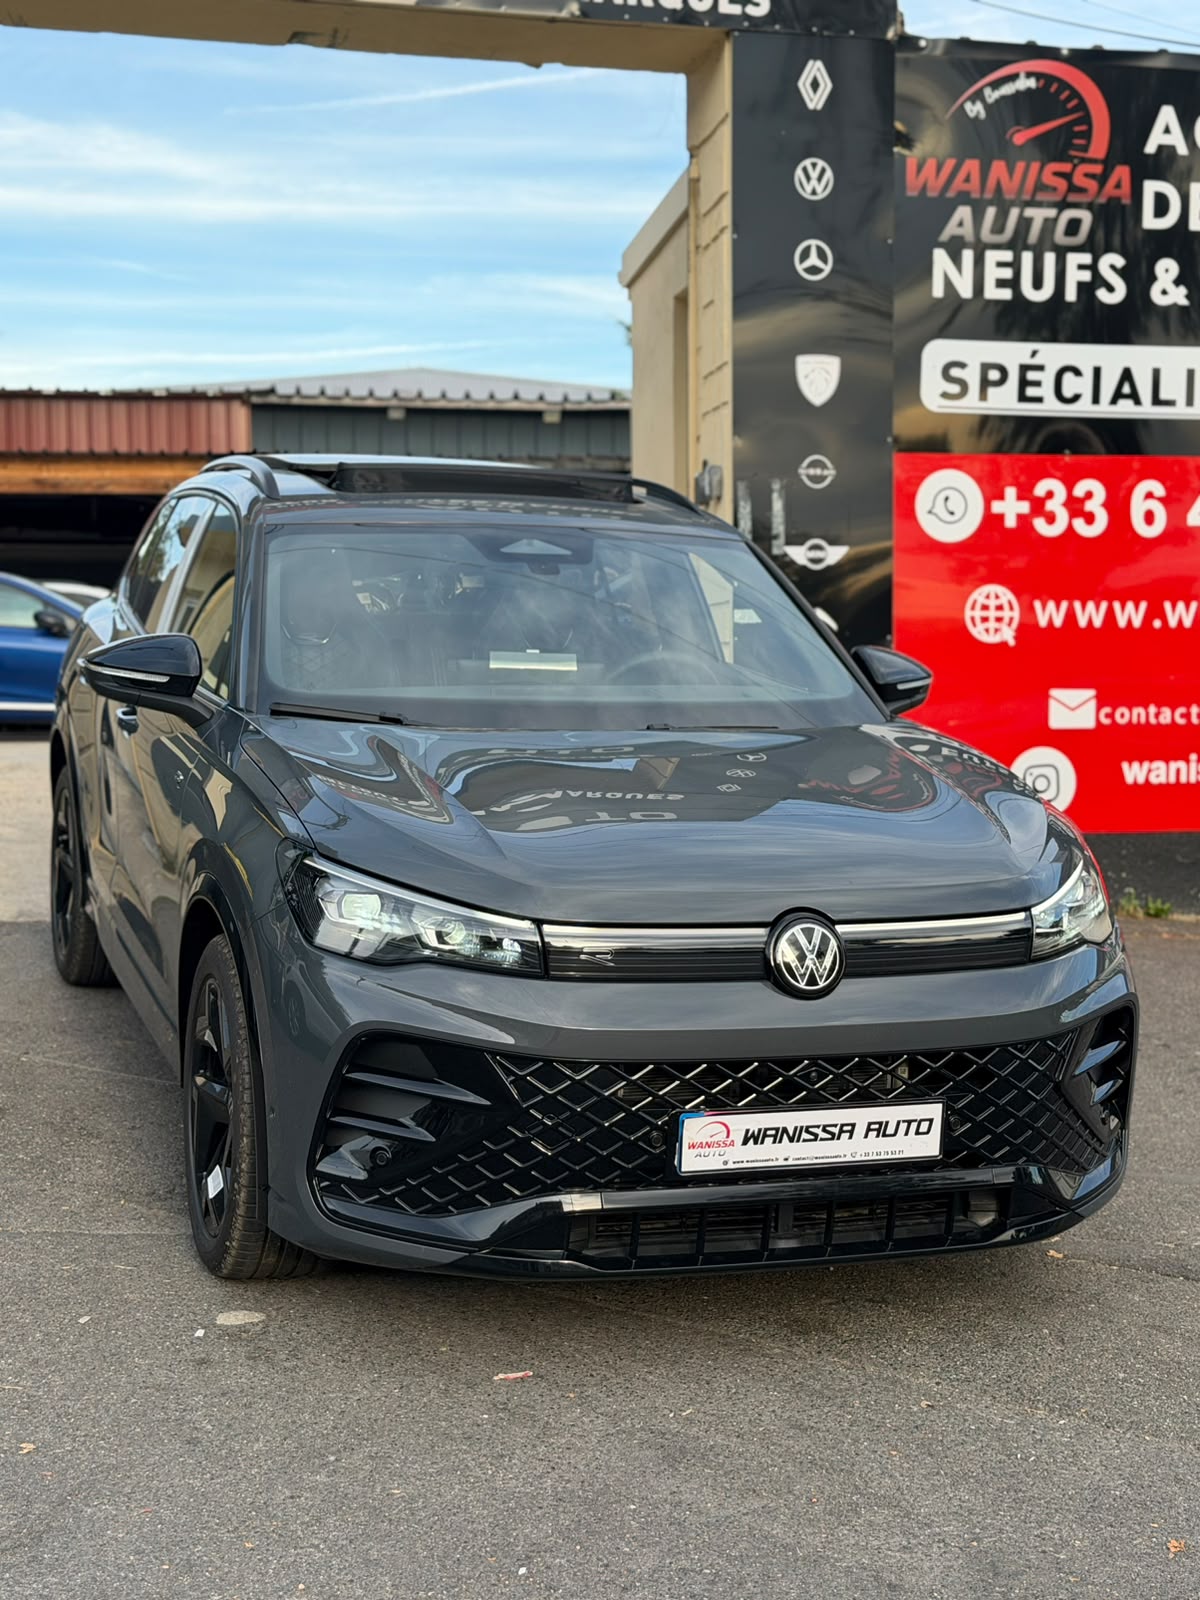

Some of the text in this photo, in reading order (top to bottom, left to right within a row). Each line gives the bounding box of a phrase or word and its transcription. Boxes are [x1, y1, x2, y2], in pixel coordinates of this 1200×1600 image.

[1143, 104, 1200, 156] A
[904, 157, 1132, 205] WANISSA
[938, 205, 1094, 246] AUTO
[932, 248, 1190, 306] NEUFS &
[939, 350, 1195, 408] SPÉCIALI
[990, 478, 1110, 538] +33
[1130, 478, 1168, 539] 6
[1098, 703, 1200, 726] contact
[1121, 752, 1200, 785] wani
[687, 1139, 736, 1151] WANISSA
[741, 1117, 935, 1147] WANISSA AUTO
